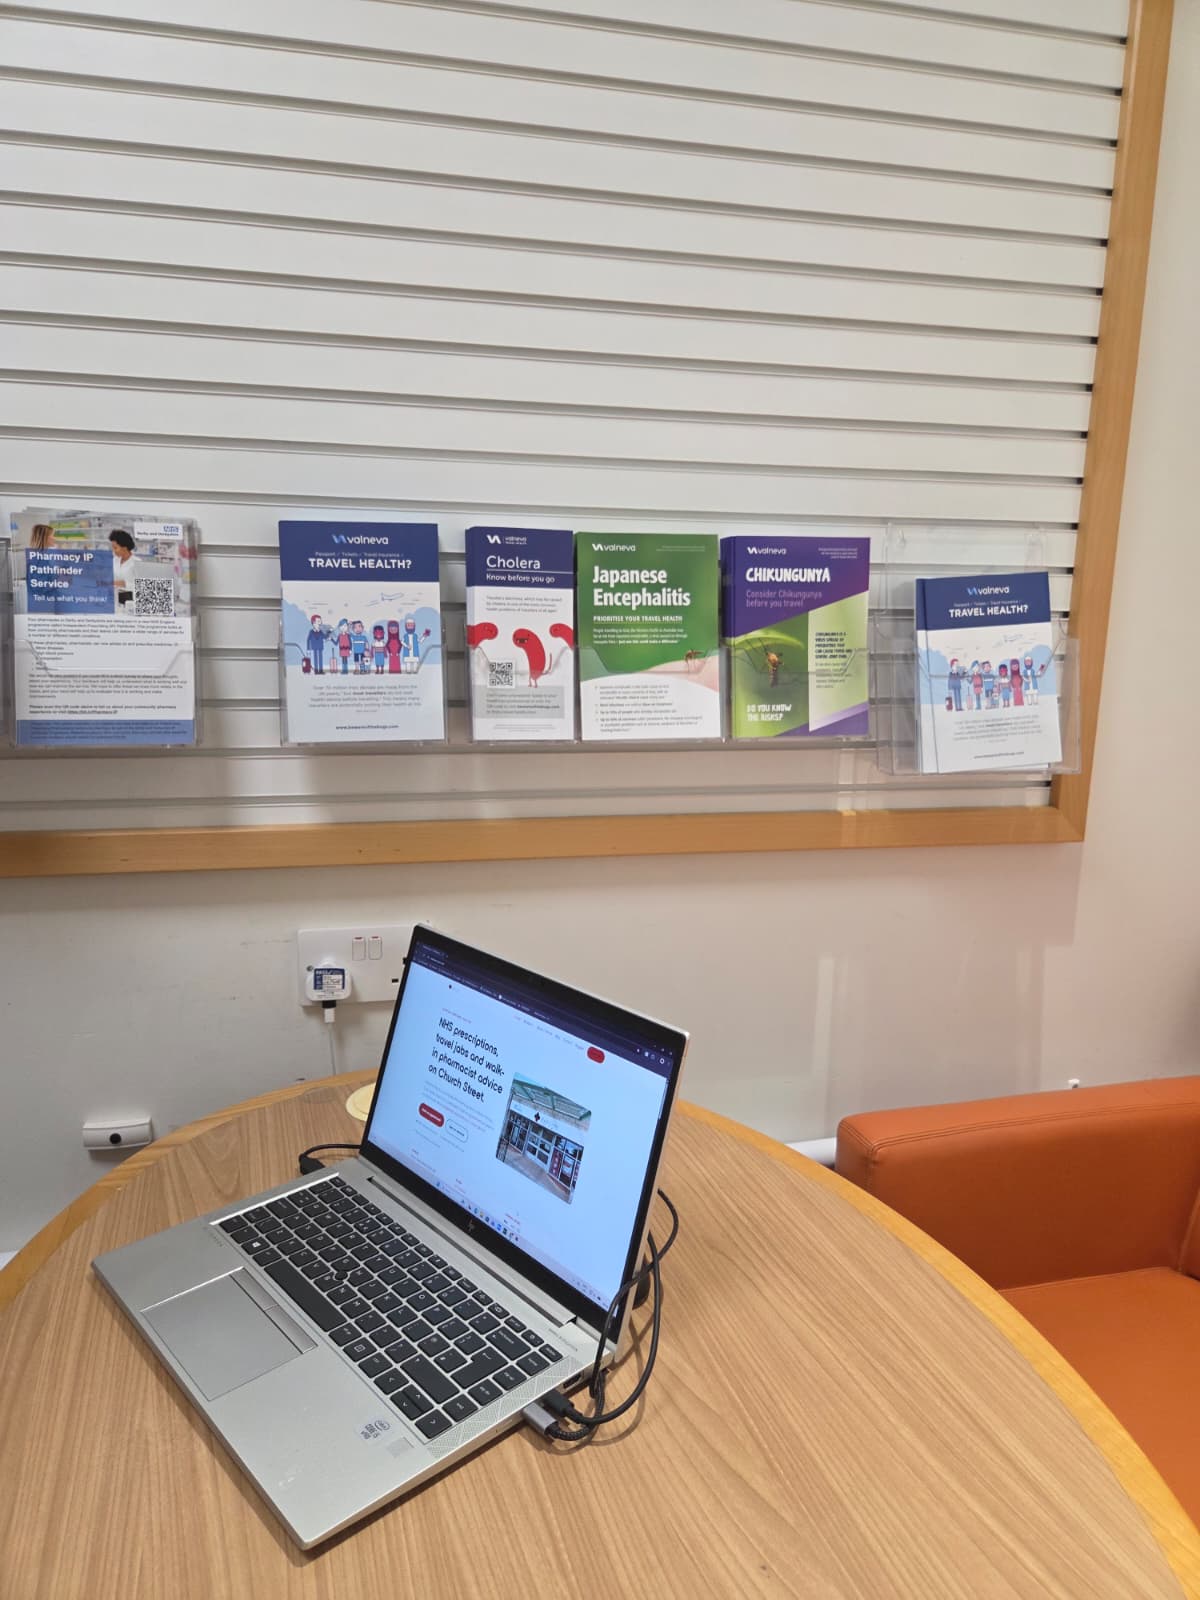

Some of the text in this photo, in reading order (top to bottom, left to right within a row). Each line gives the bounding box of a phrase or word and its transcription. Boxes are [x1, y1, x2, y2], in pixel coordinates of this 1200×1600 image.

[347, 535, 389, 545] valneva
[603, 544, 636, 552] valneva
[756, 547, 787, 555] valneva
[29, 551, 94, 563] Pharmacy IP
[486, 555, 541, 570] Cholera
[308, 558, 412, 569] TRAVEL HEALTH?
[30, 565, 83, 576] Pathfinder
[745, 567, 831, 583] CHIKUNGUNYA
[486, 573, 555, 584] Know before you go
[592, 565, 668, 588] Japanese
[30, 579, 69, 589] Service
[746, 589, 823, 600] Consider Chikungunya
[977, 585, 1010, 596] valneva
[593, 587, 691, 611] Encephalitis
[746, 599, 804, 608] before you travel
[948, 604, 1029, 619] TRAVEL HEALTH?
[593, 615, 683, 623] PRIORITISE YOUR TRAVEL HEALTH
[438, 1016, 454, 1032] NHS
[453, 1027, 499, 1057] prescriptions,
[436, 1033, 454, 1050] travel
[470, 1053, 485, 1066] and
[485, 1060, 505, 1076] walk-
[431, 1046, 503, 1094] in pharmacist advice
[428, 1064, 437, 1075] on
[438, 1067, 462, 1089] Church
